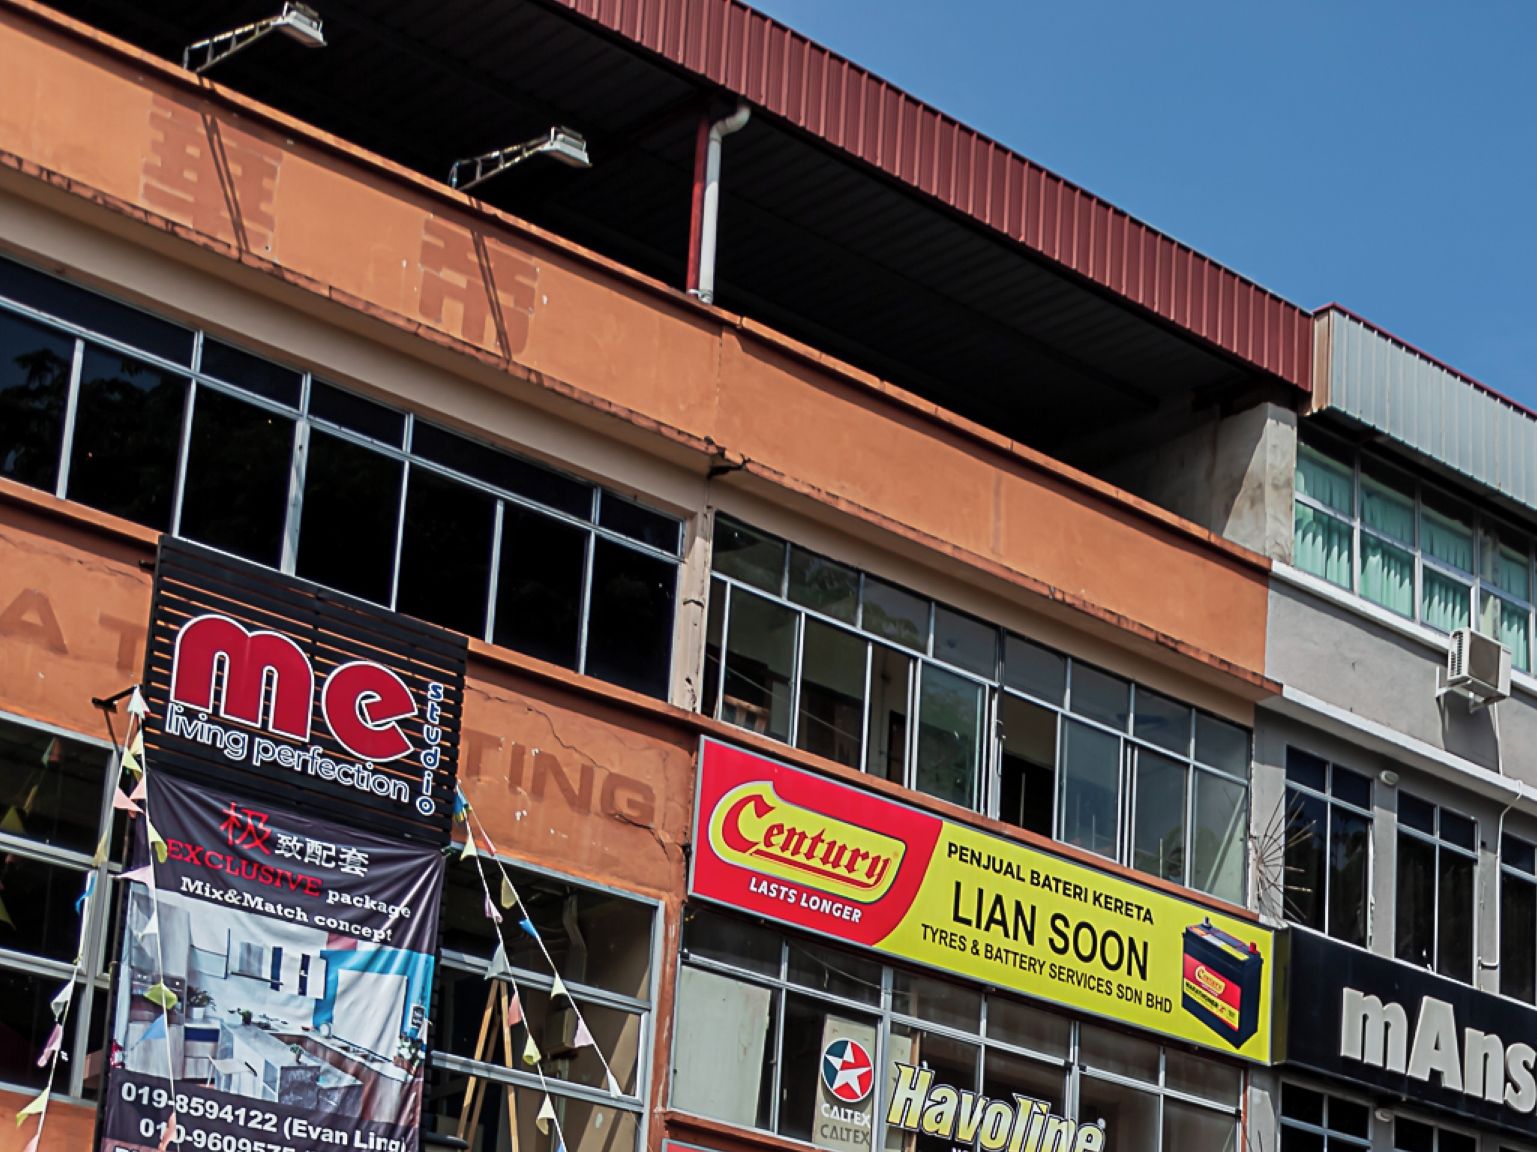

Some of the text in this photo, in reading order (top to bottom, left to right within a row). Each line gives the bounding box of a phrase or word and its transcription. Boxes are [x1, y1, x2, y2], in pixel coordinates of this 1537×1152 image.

[172, 613, 418, 763] me
[166, 703, 410, 804] living perfection
[416, 682, 444, 815] studio
[166, 838, 411, 919] EXCLUSIVE package
[219, 801, 369, 878] 极致配套
[722, 794, 892, 887] Century
[180, 876, 392, 944] Mix&Match concept
[750, 877, 862, 923] LASTS LONGER
[947, 842, 1154, 925] PENJUAL BATERI KERETA
[921, 924, 1172, 1014] TYRES & BATTERY SERVICES SDN BHD
[953, 881, 1148, 981] LIAN SOON
[121, 1082, 278, 1133] 019-8594122
[283, 1116, 347, 1147] (Evan
[820, 1103, 871, 1129] CALTEX
